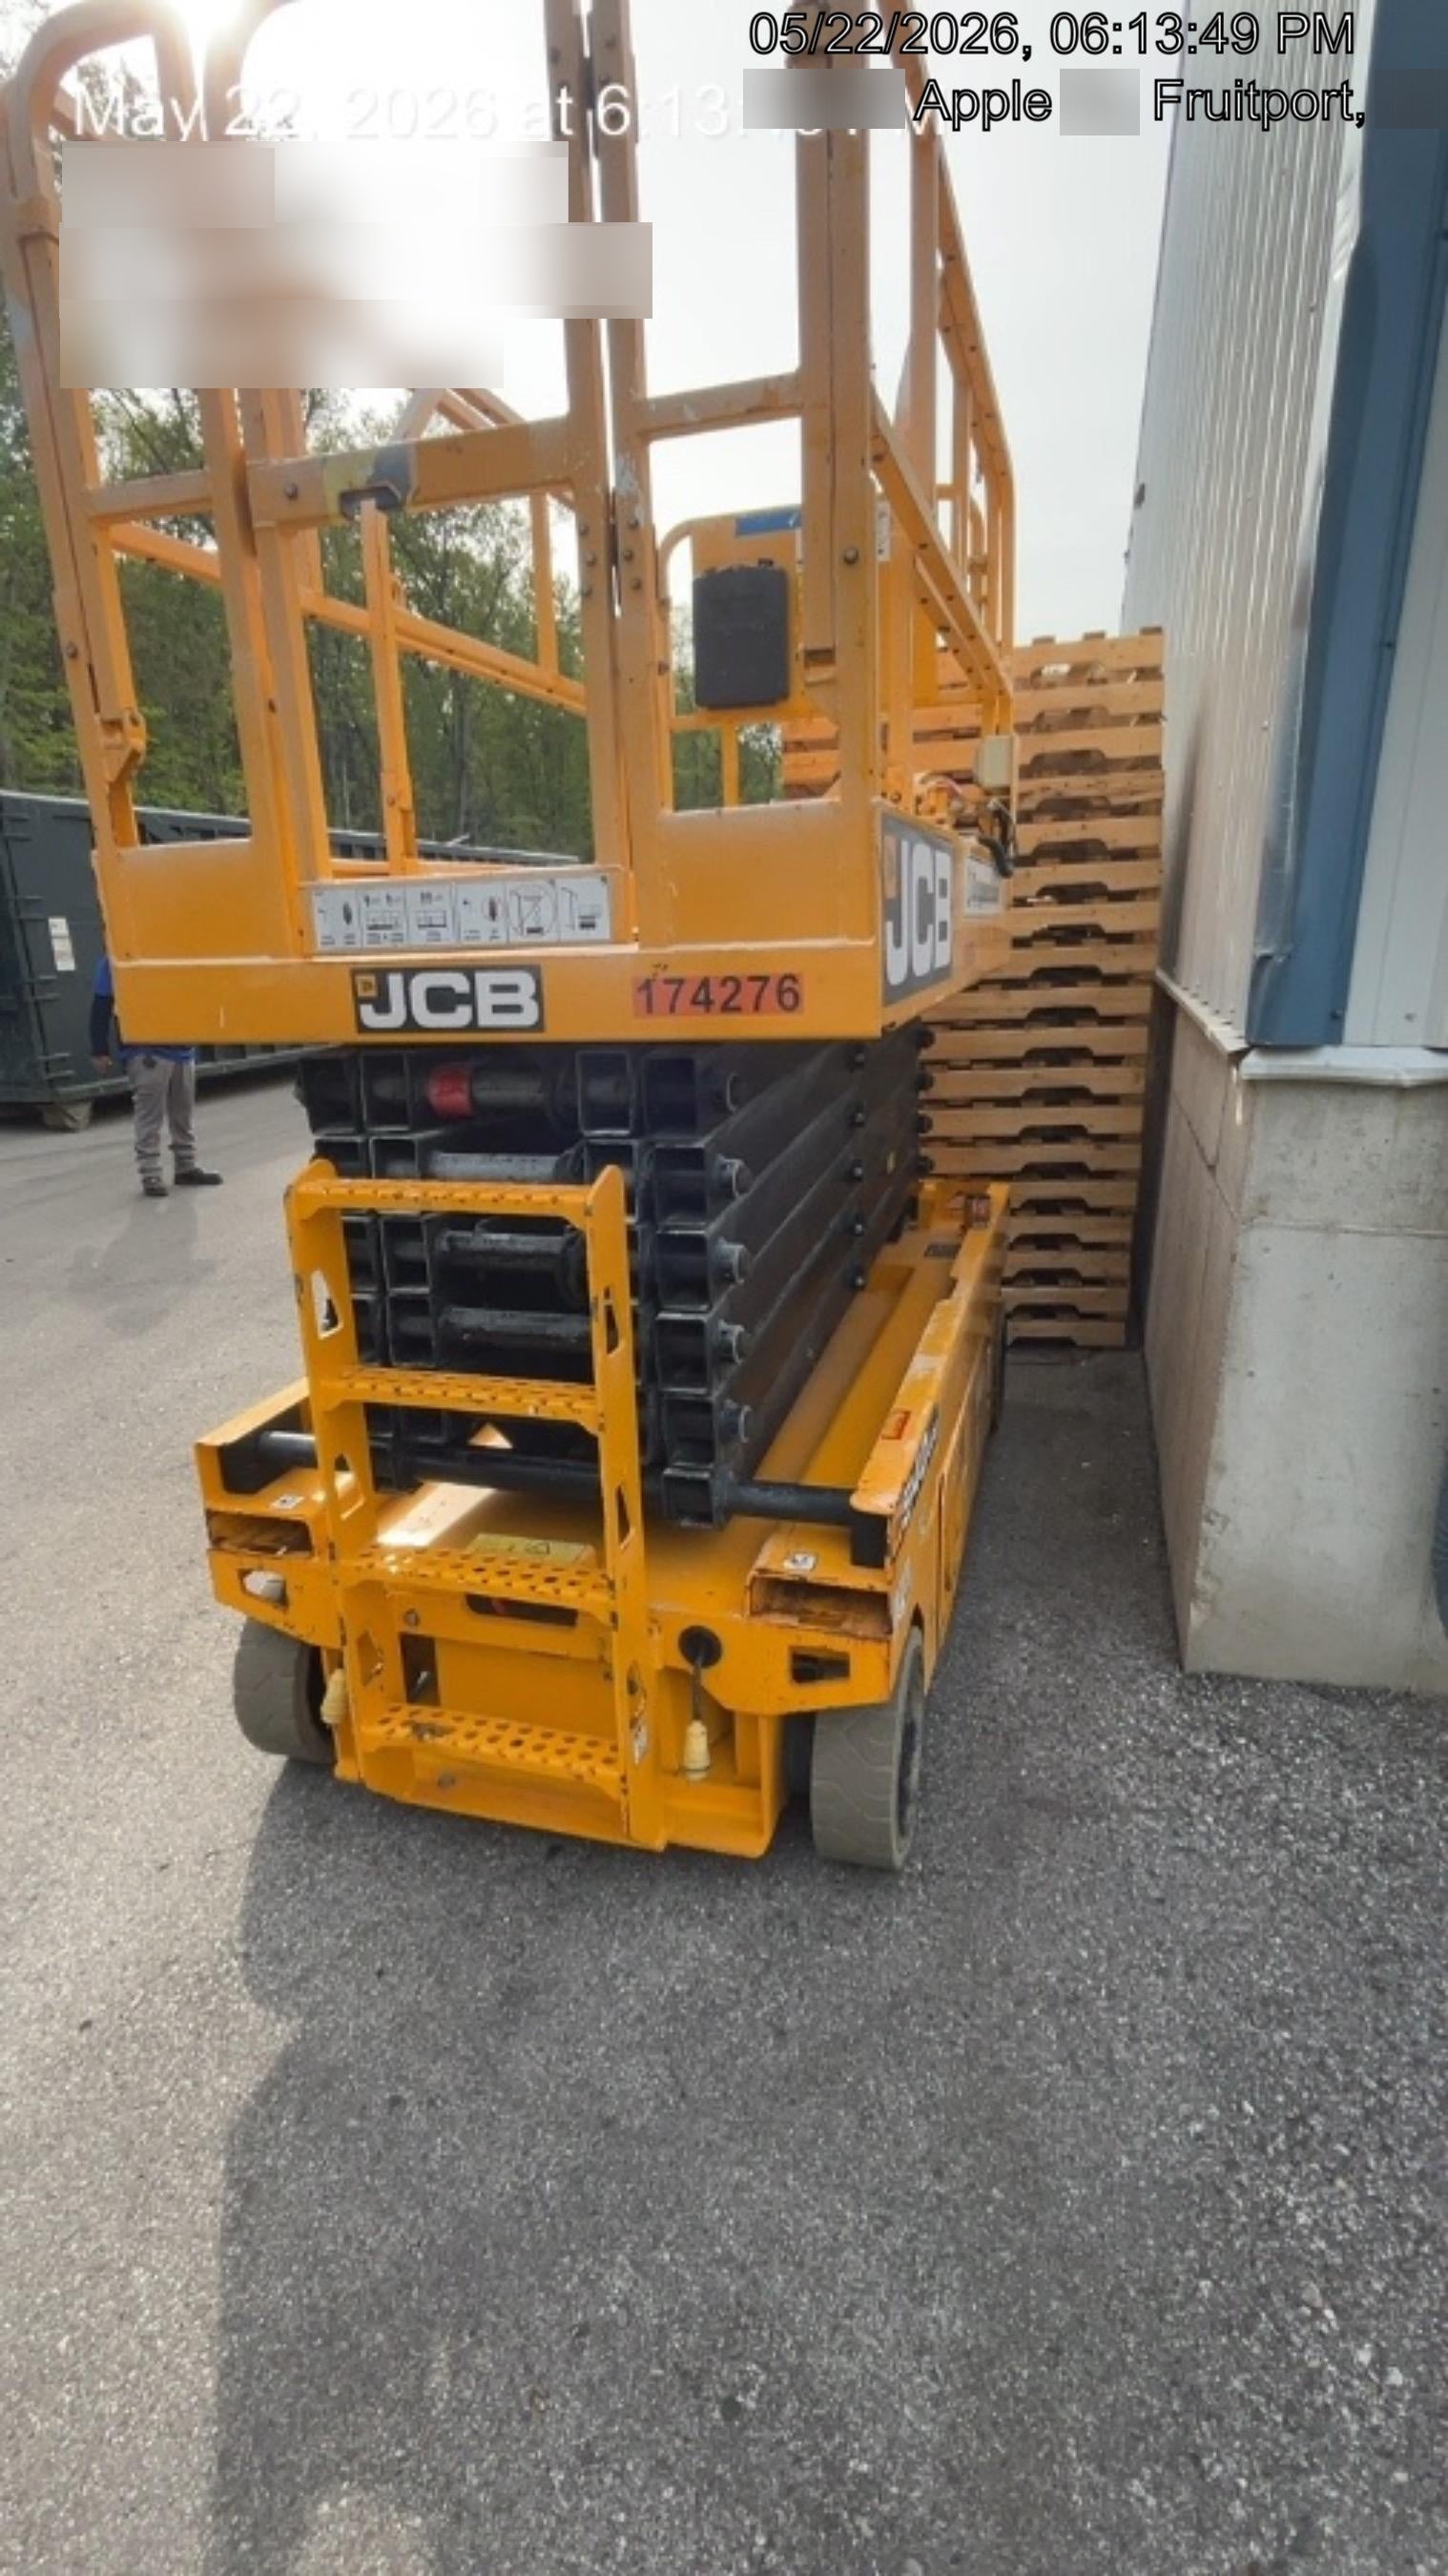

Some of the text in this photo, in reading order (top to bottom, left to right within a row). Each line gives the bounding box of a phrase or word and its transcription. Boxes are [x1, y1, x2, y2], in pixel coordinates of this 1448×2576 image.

[884, 837, 952, 986] JCB
[359, 969, 540, 1029] JCB
[637, 973, 800, 1014] 174276
